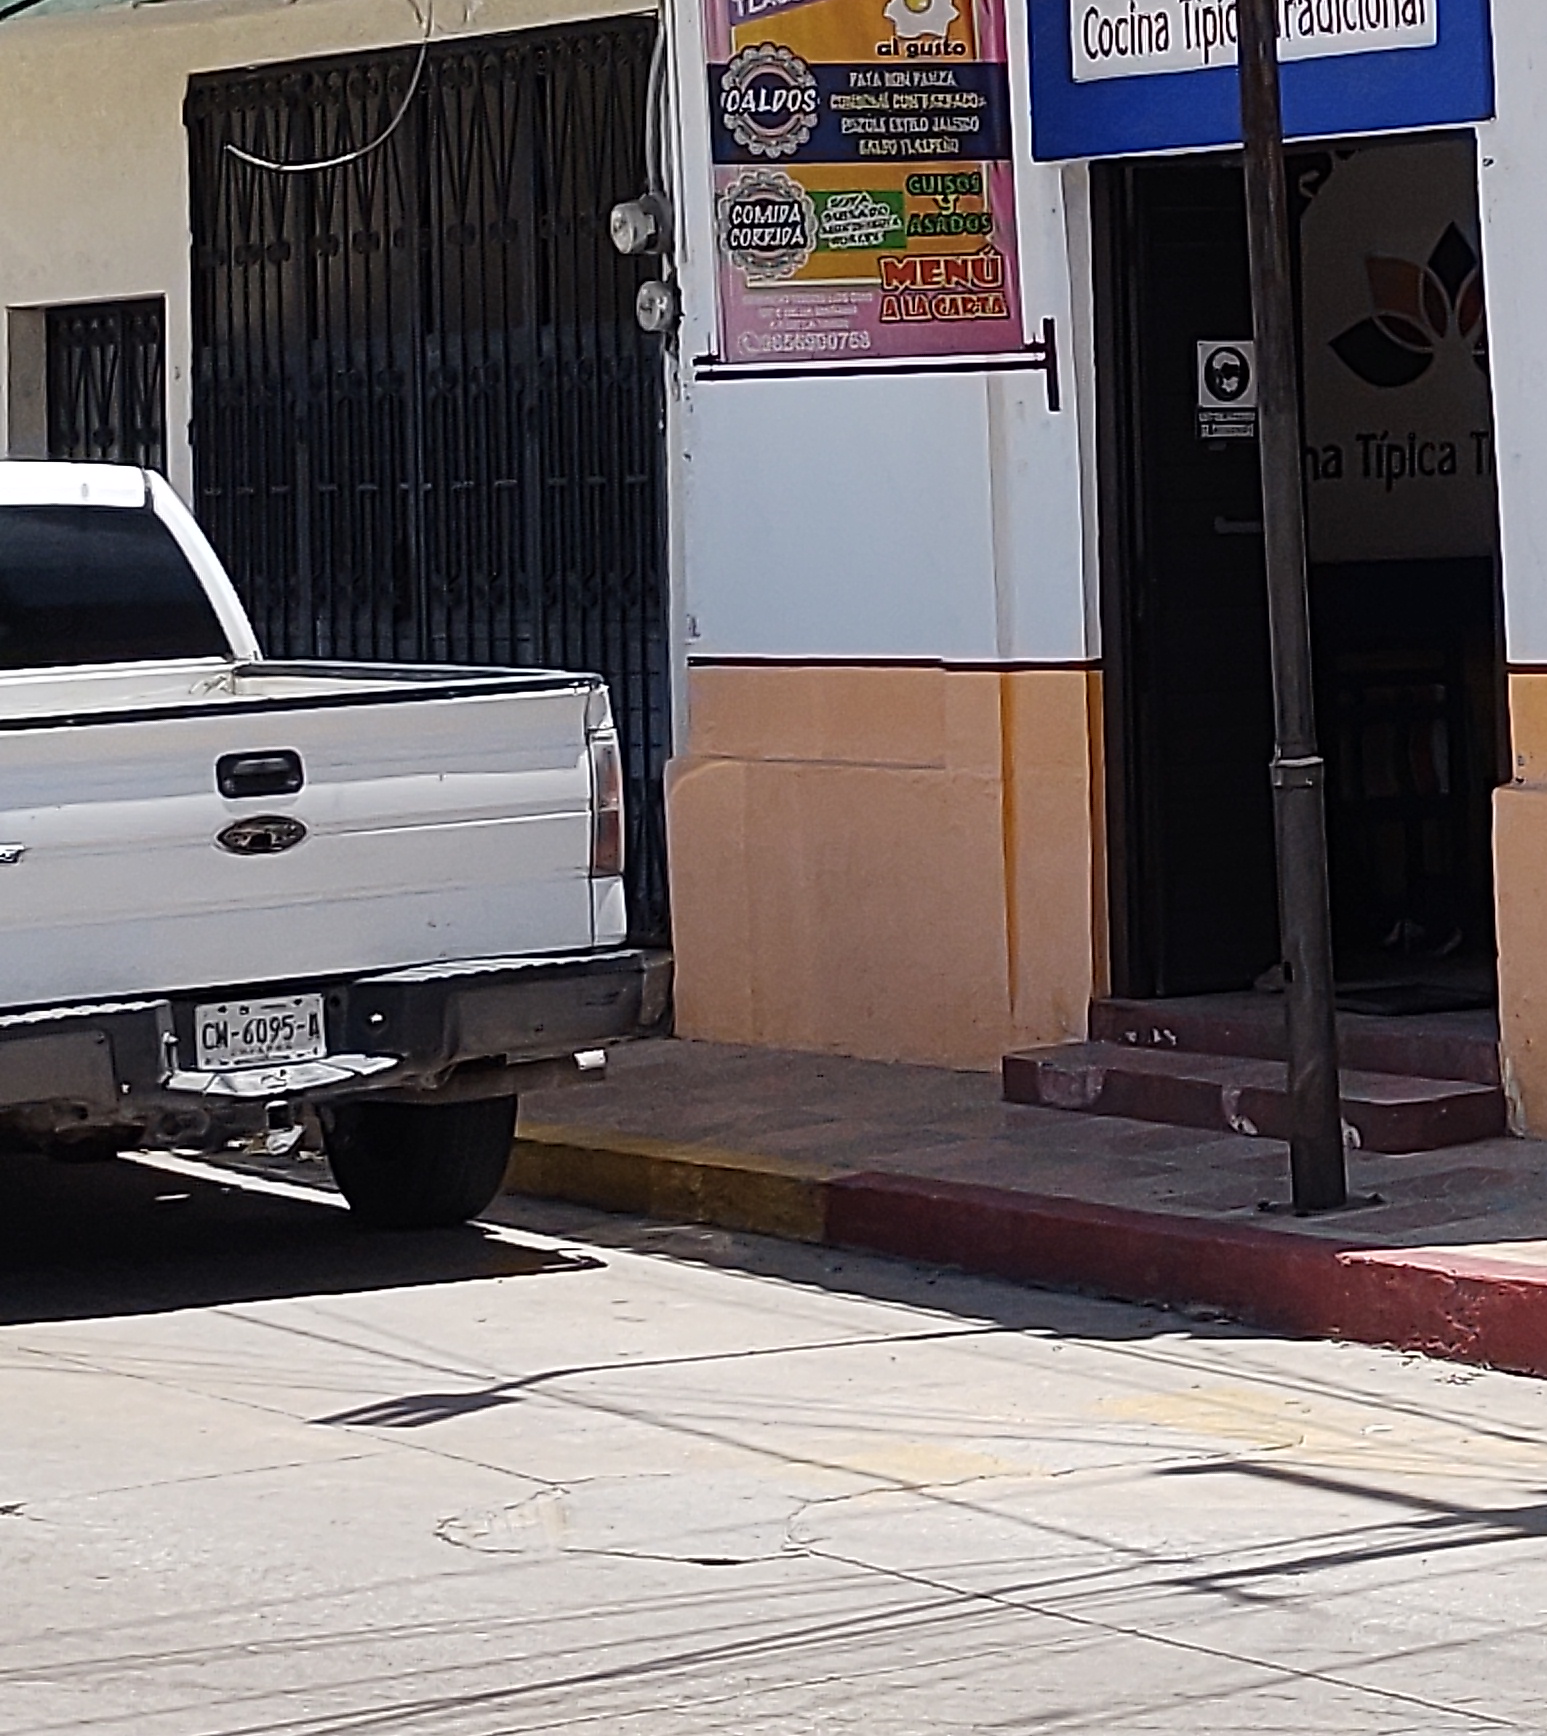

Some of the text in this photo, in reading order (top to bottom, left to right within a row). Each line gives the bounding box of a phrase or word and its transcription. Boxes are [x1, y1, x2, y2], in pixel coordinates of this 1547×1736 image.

[1083, 0, 1170, 60] Cocina
[906, 39, 966, 58] gusto
[726, 87, 818, 113] CALDOS
[732, 204, 800, 224] COMIDA
[909, 215, 991, 234] ASADOS
[730, 227, 804, 246] CORRIDA
[882, 246, 1002, 288] MENÚ
[882, 296, 900, 320] A
[902, 295, 931, 320] LA
[932, 294, 1008, 318] CARTA
[1355, 430, 1457, 493] Típica
